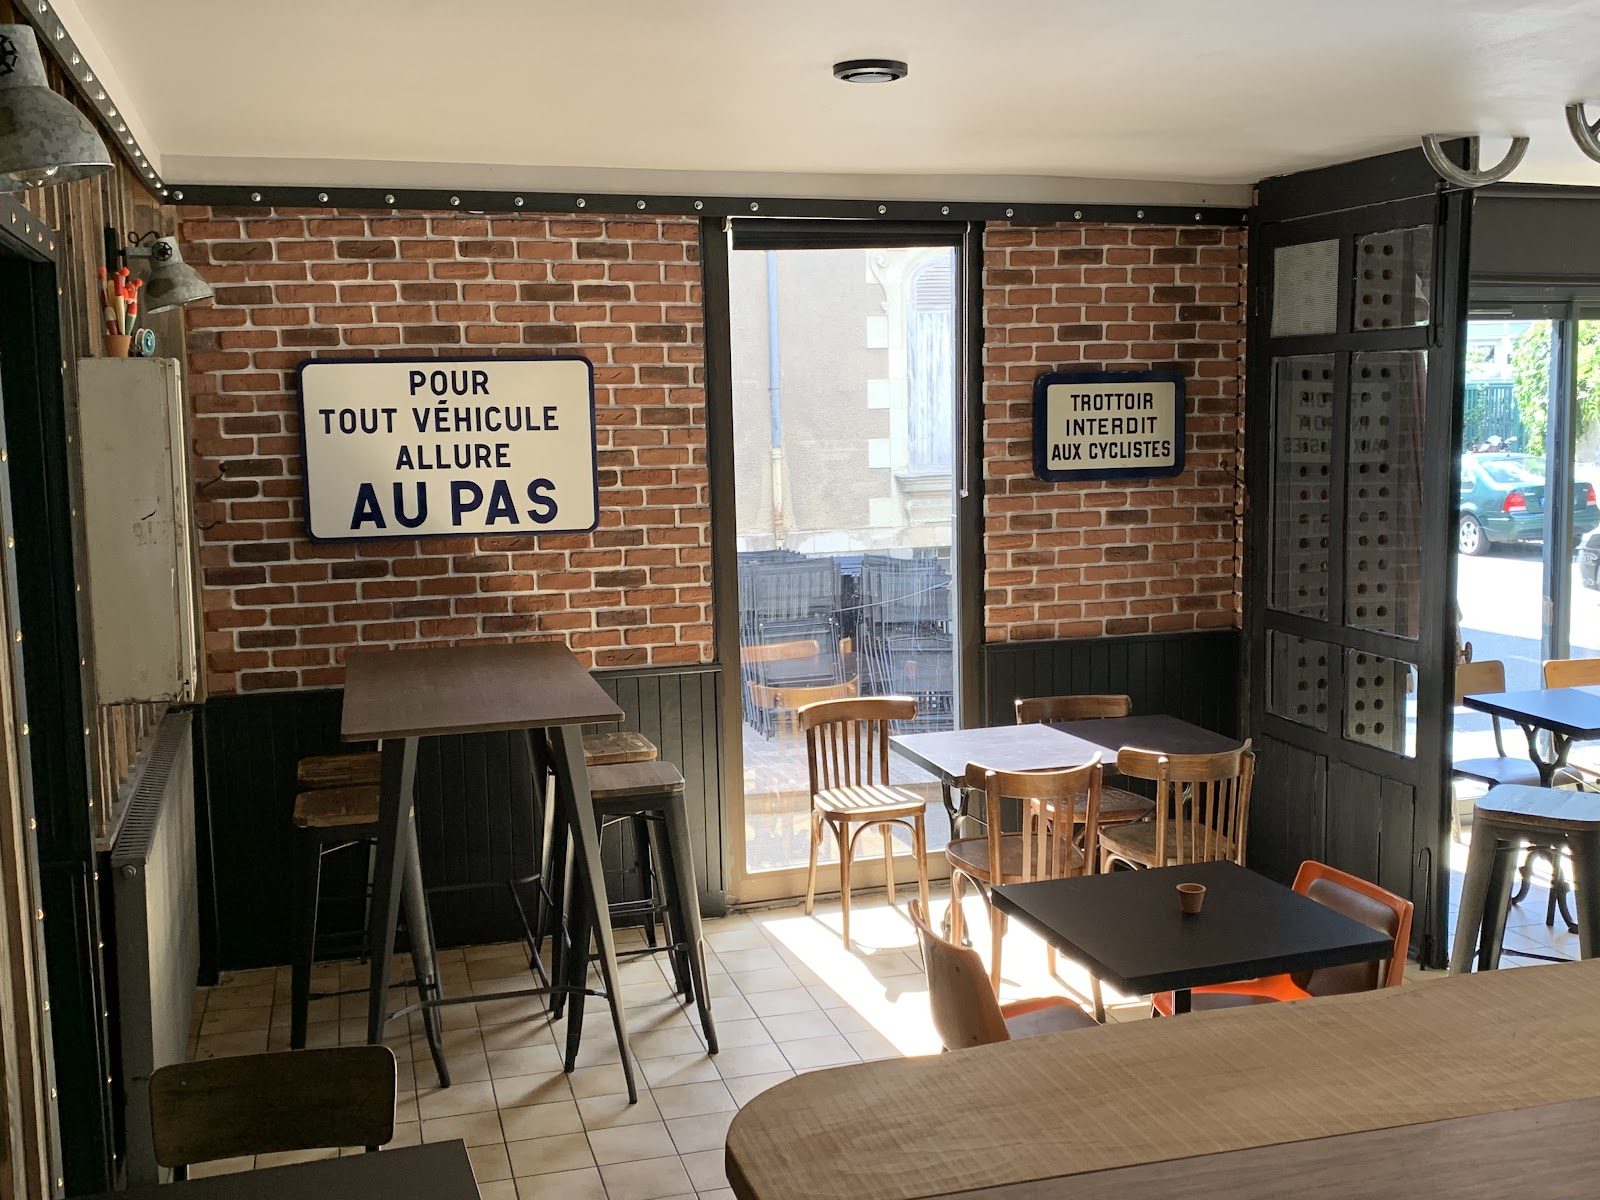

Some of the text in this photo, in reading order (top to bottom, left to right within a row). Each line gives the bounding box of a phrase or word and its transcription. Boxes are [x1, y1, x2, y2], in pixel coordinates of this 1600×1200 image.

[409, 370, 490, 396] POUR
[1070, 393, 1153, 411] TROTTOIR
[318, 400, 559, 434] TOUT VÉHICULE
[1066, 416, 1158, 436] INTERDIT
[395, 443, 511, 470] ALLURE
[1051, 440, 1171, 461] AUX CYCLISTES
[350, 477, 558, 530] AU PAS
